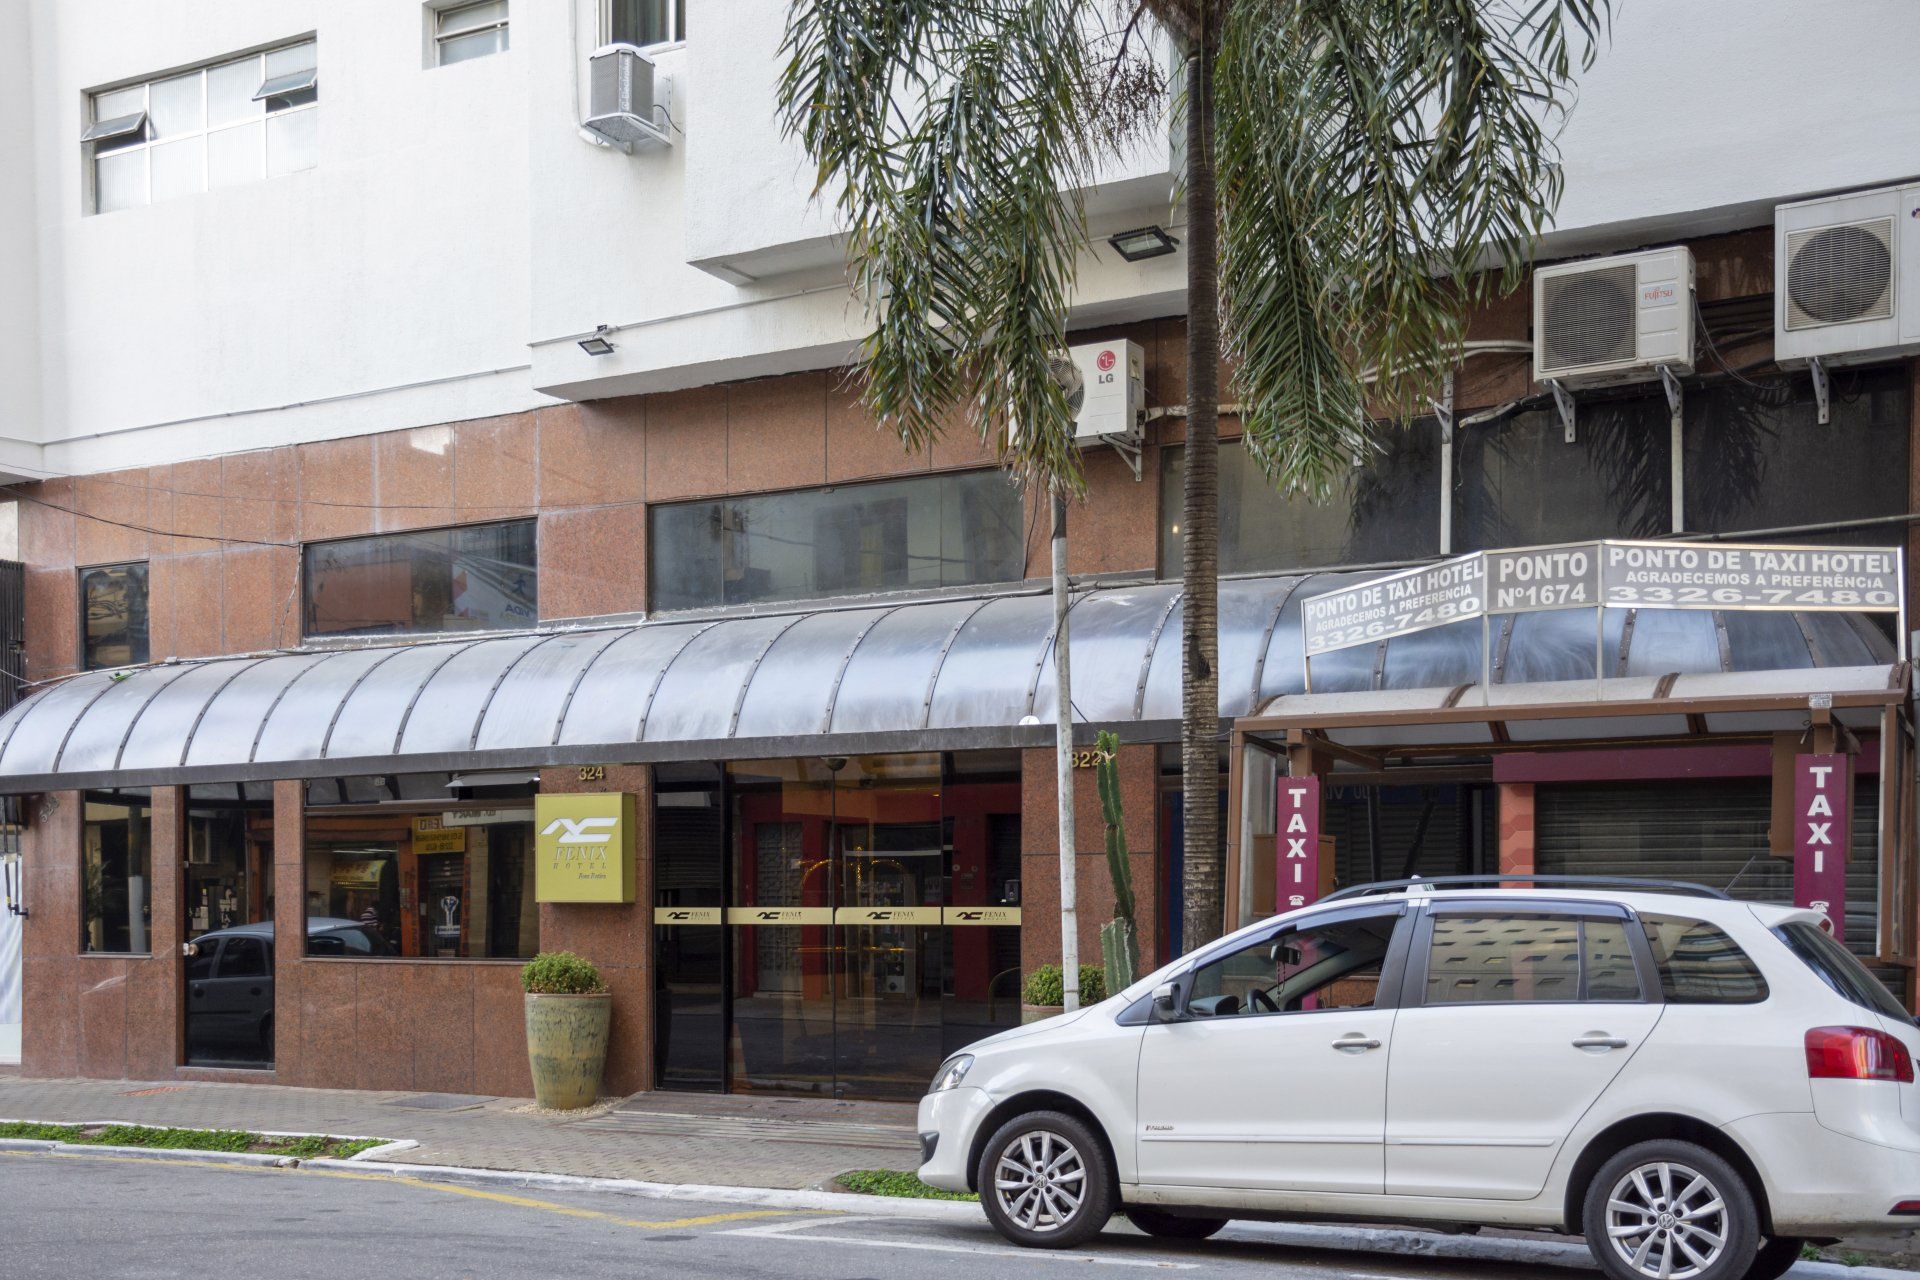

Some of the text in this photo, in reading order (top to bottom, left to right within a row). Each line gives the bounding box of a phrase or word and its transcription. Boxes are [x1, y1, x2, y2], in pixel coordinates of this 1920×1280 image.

[1644, 286, 1673, 301] FUJITSU
[1098, 373, 1114, 384] LG
[1499, 551, 1588, 582] PONTO
[1609, 547, 1895, 574] PONTO DE TAXI HOTEL
[1625, 570, 1750, 585] AGRADECEMOS
[1755, 574, 1767, 586] A
[1306, 559, 1483, 621] PONTO DE TAXI HOTEL
[1608, 586, 1896, 605] 3326-7480
[1309, 596, 1480, 650] 3326-7480
[1315, 607, 1386, 633] AGRADECEMOS
[1388, 606, 1396, 616] A
[578, 766, 604, 781] 324
[1807, 766, 1833, 872] TAXI
[1286, 788, 1307, 883] TAXI
[552, 846, 608, 860] FENIX
[553, 862, 607, 870] HOTEL
